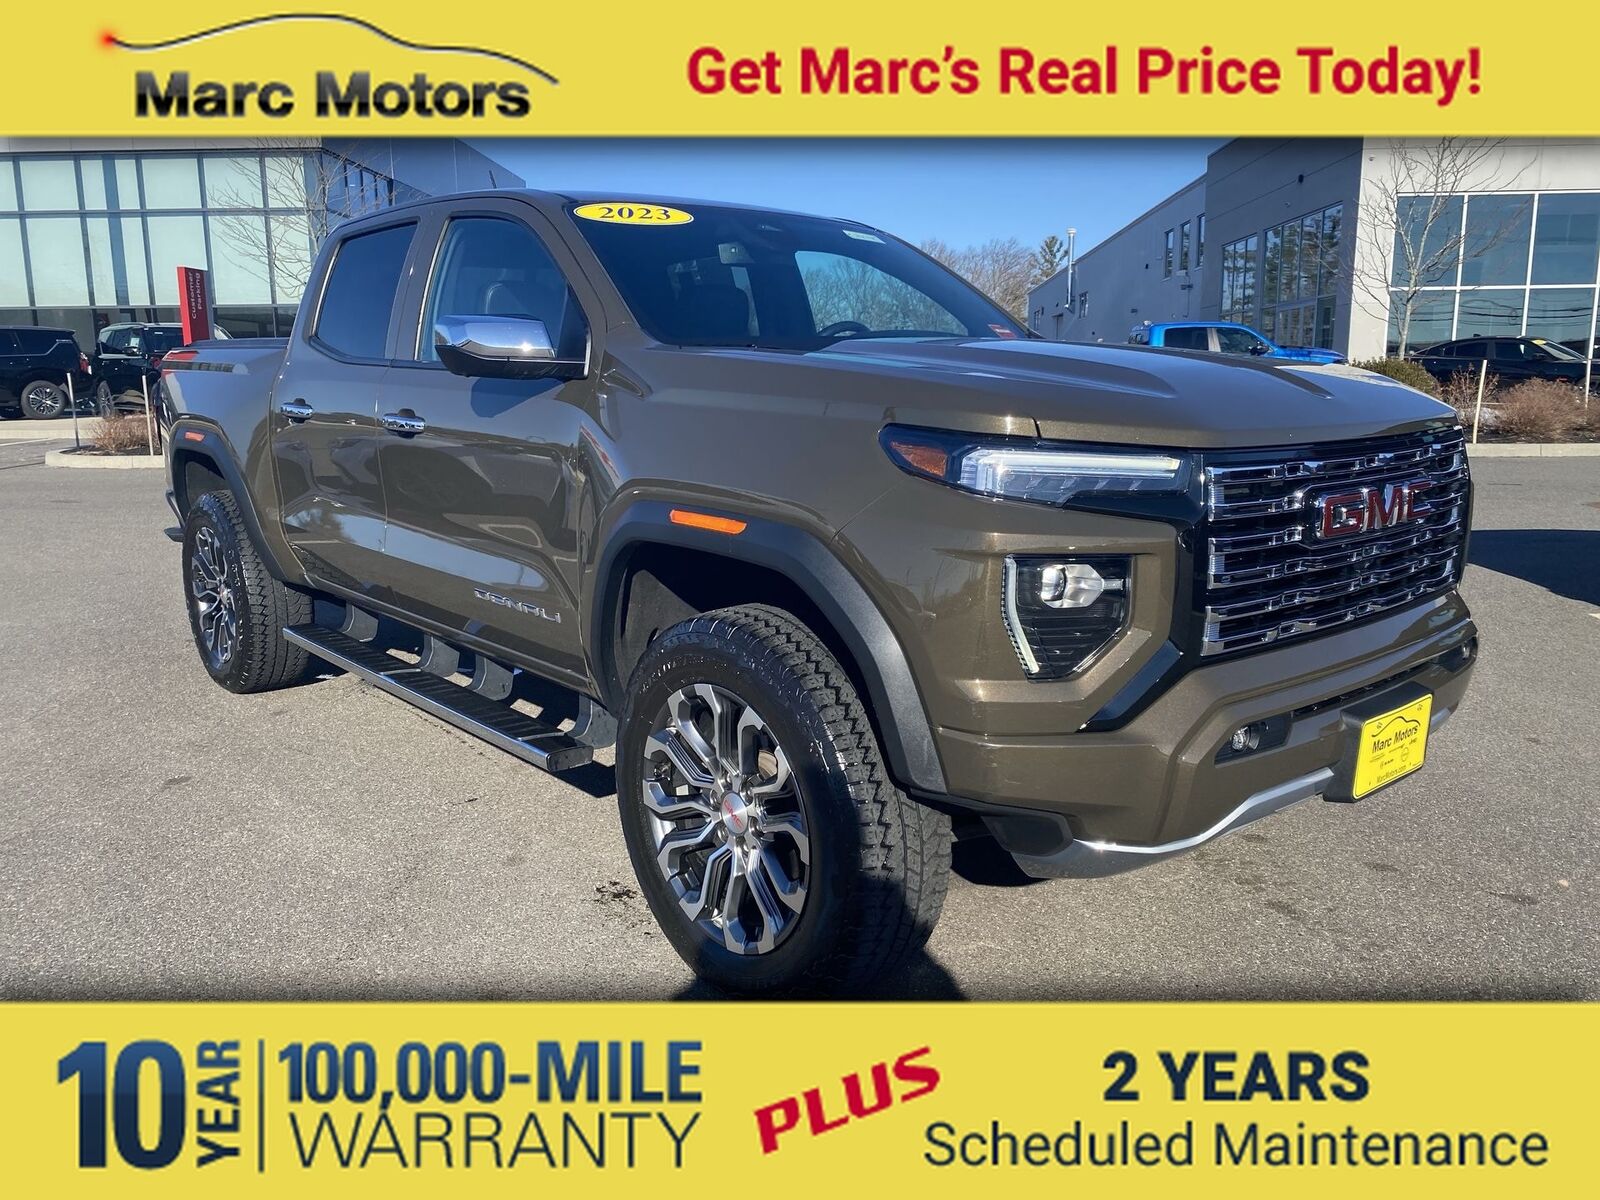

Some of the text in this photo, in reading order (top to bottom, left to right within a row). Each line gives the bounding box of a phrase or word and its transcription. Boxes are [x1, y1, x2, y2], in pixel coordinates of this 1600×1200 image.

[598, 206, 671, 220] 2023
[1319, 479, 1432, 538] GMC
[474, 587, 562, 624] DENALI
[1372, 737, 1392, 754] Marc
[1393, 725, 1418, 745] Motors
[723, 799, 744, 829] GMC
